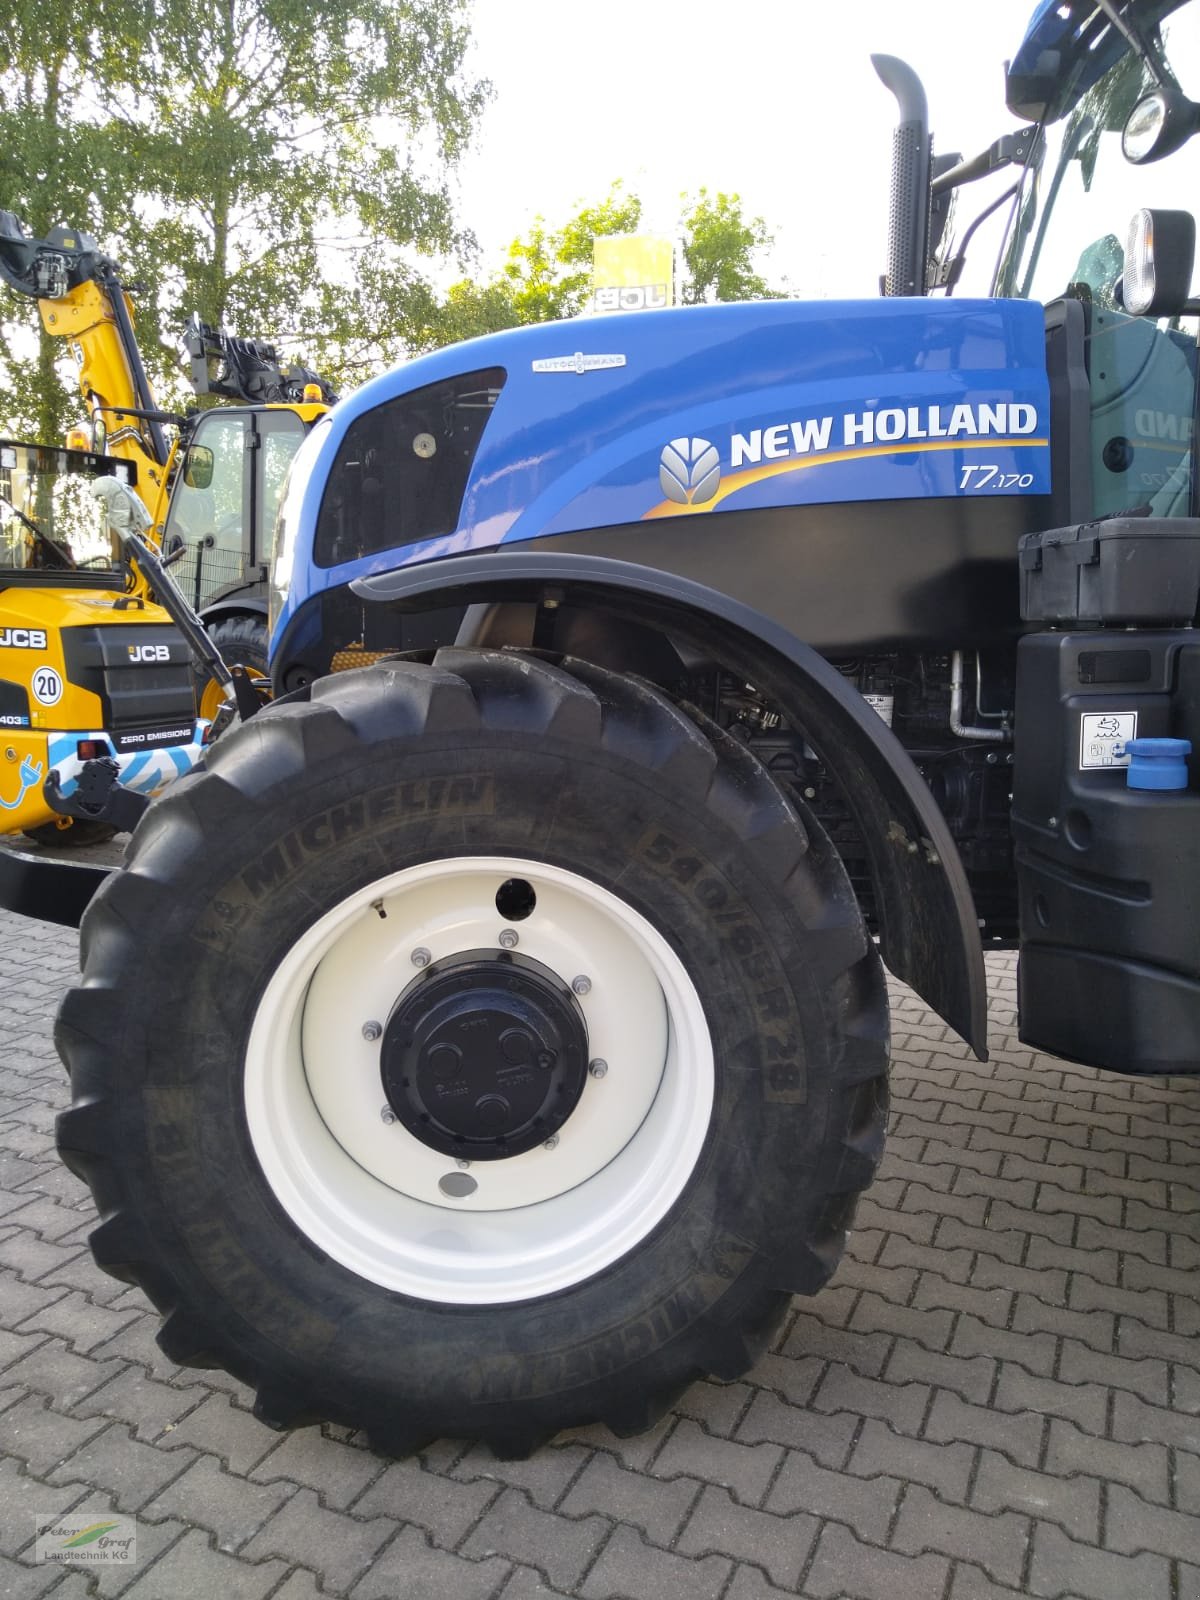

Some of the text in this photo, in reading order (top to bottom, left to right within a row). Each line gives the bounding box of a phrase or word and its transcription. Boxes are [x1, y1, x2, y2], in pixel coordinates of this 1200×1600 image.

[730, 403, 1038, 468] NEW HOLLAND
[959, 464, 1035, 489] T7.170
[0, 628, 47, 649] JCB
[128, 645, 170, 662] JCB
[37, 675, 57, 697] 20
[120, 728, 192, 744] ZERO EMISSIONS
[239, 775, 488, 900] MICHELIN
